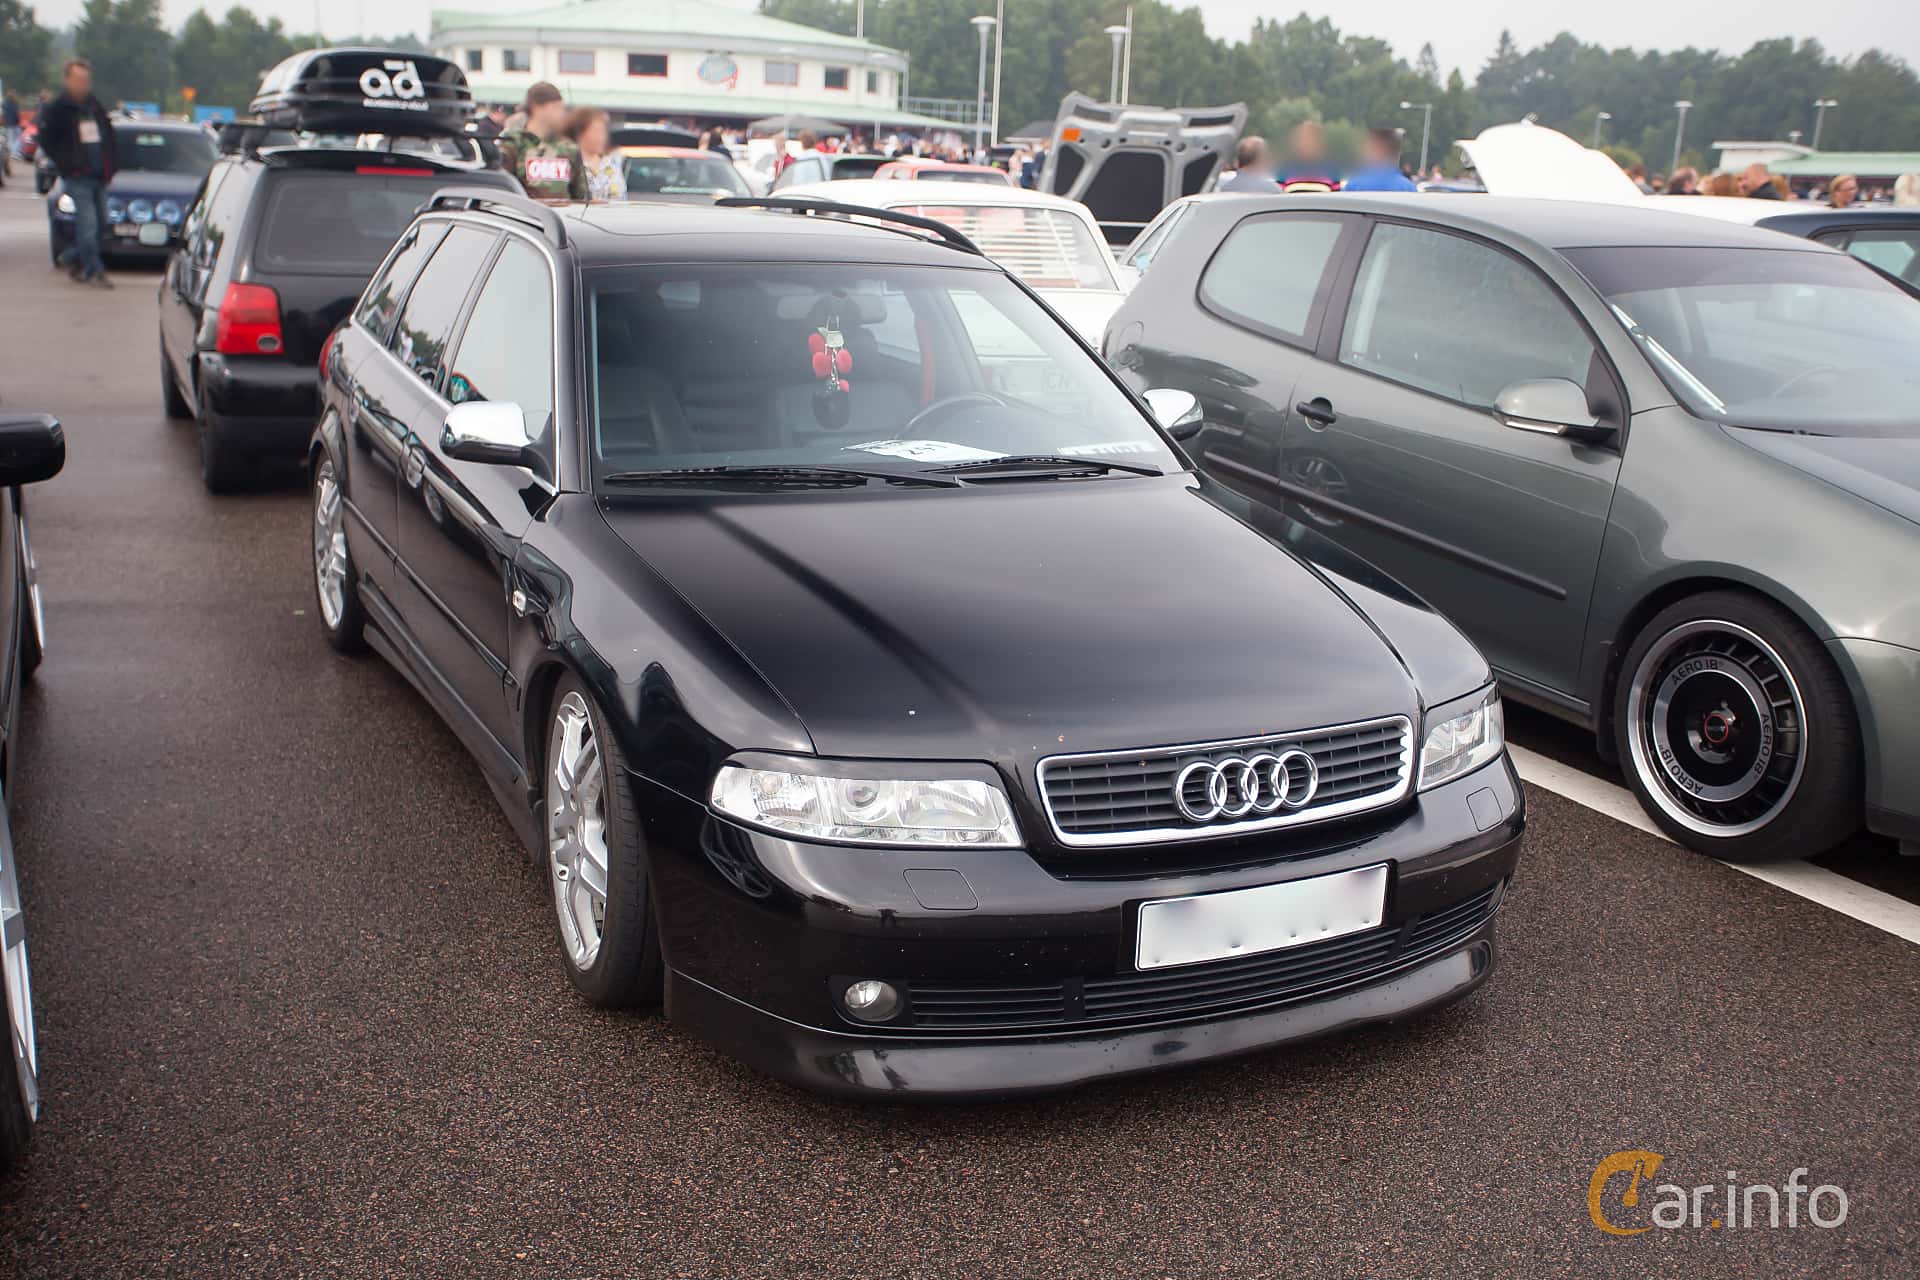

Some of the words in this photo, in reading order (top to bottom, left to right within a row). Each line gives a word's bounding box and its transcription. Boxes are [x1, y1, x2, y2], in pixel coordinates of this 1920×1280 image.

[1671, 660, 1703, 685] AERO
[1761, 713, 1773, 756] AERO
[1670, 765, 1704, 796] AERO
